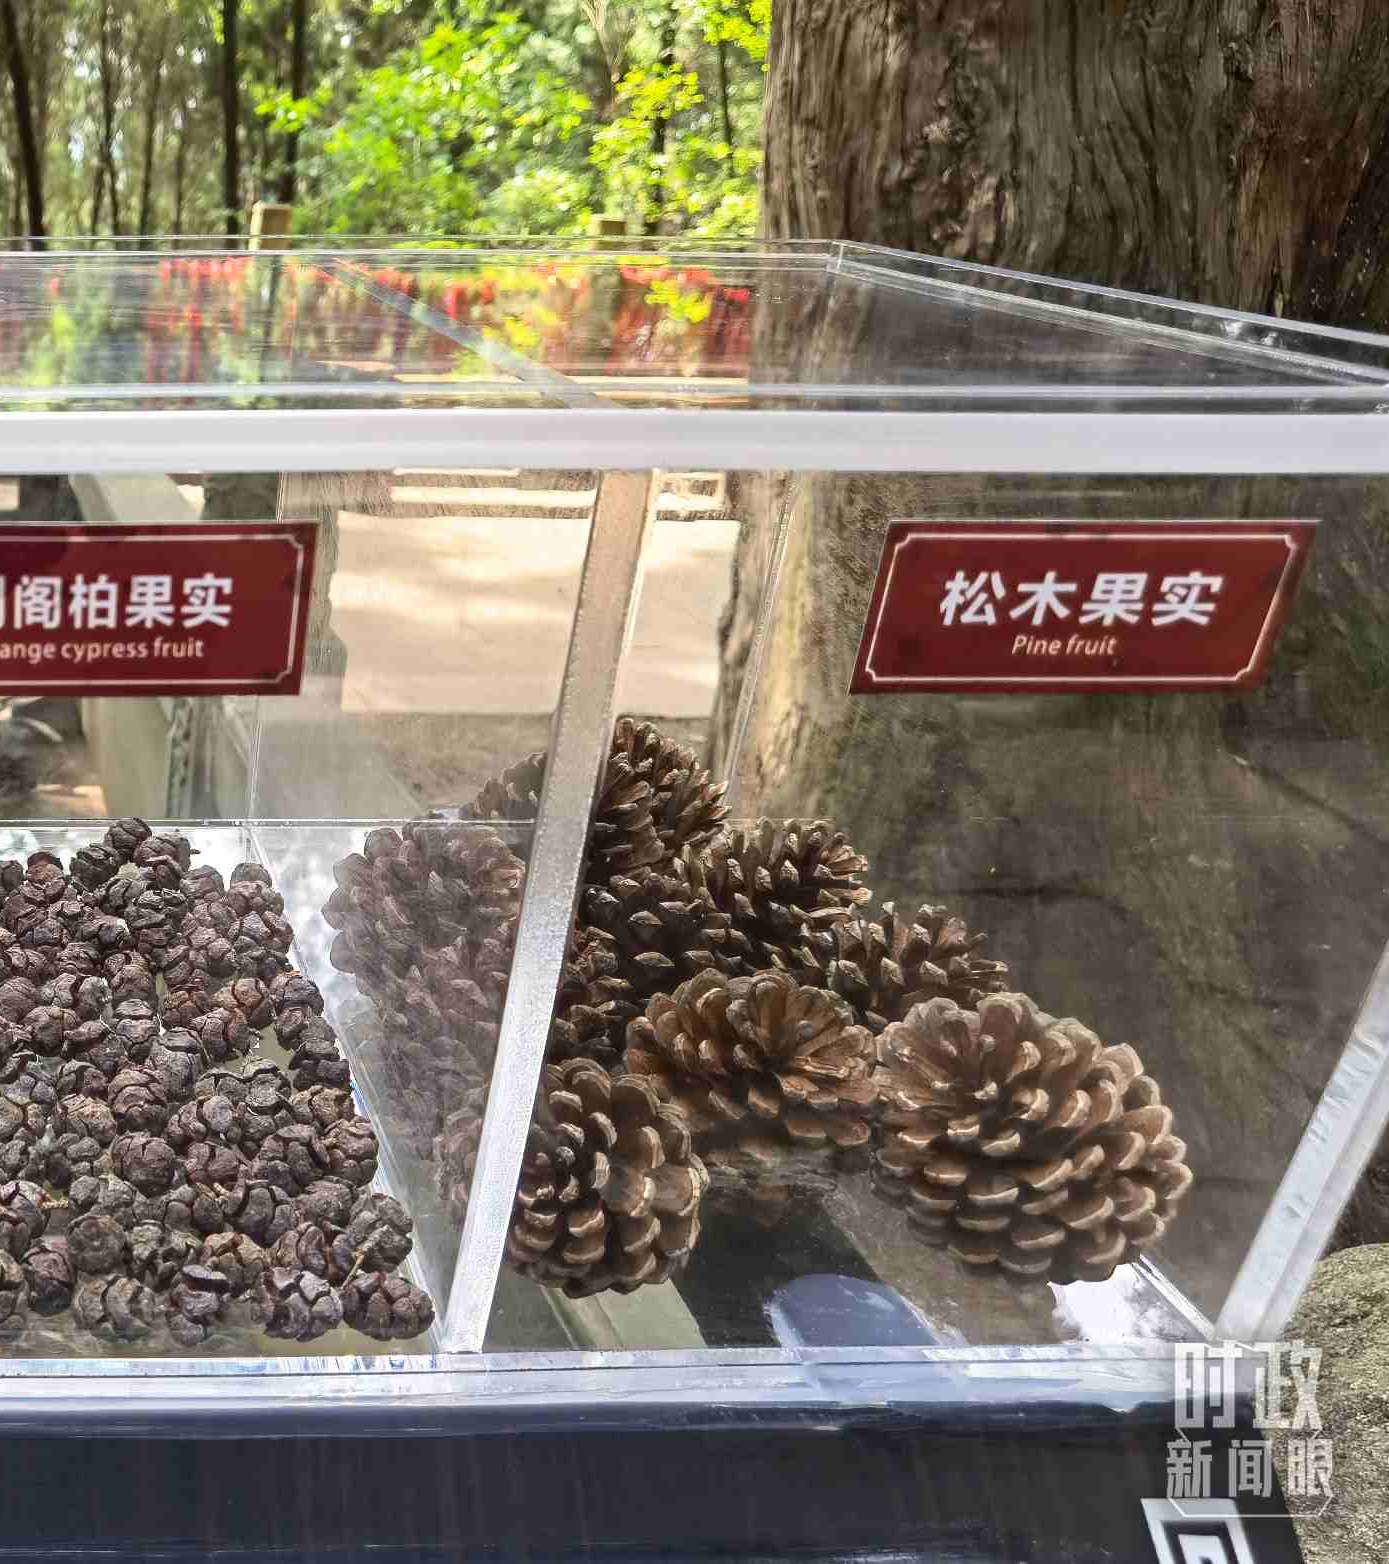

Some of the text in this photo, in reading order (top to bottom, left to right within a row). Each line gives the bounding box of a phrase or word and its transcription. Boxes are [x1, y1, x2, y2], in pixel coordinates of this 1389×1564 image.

[938, 570, 1224, 627] 松木果实
[60, 642, 149, 663] cypress
[153, 637, 204, 659] fruit
[1011, 634, 1118, 656] Pine fruit
